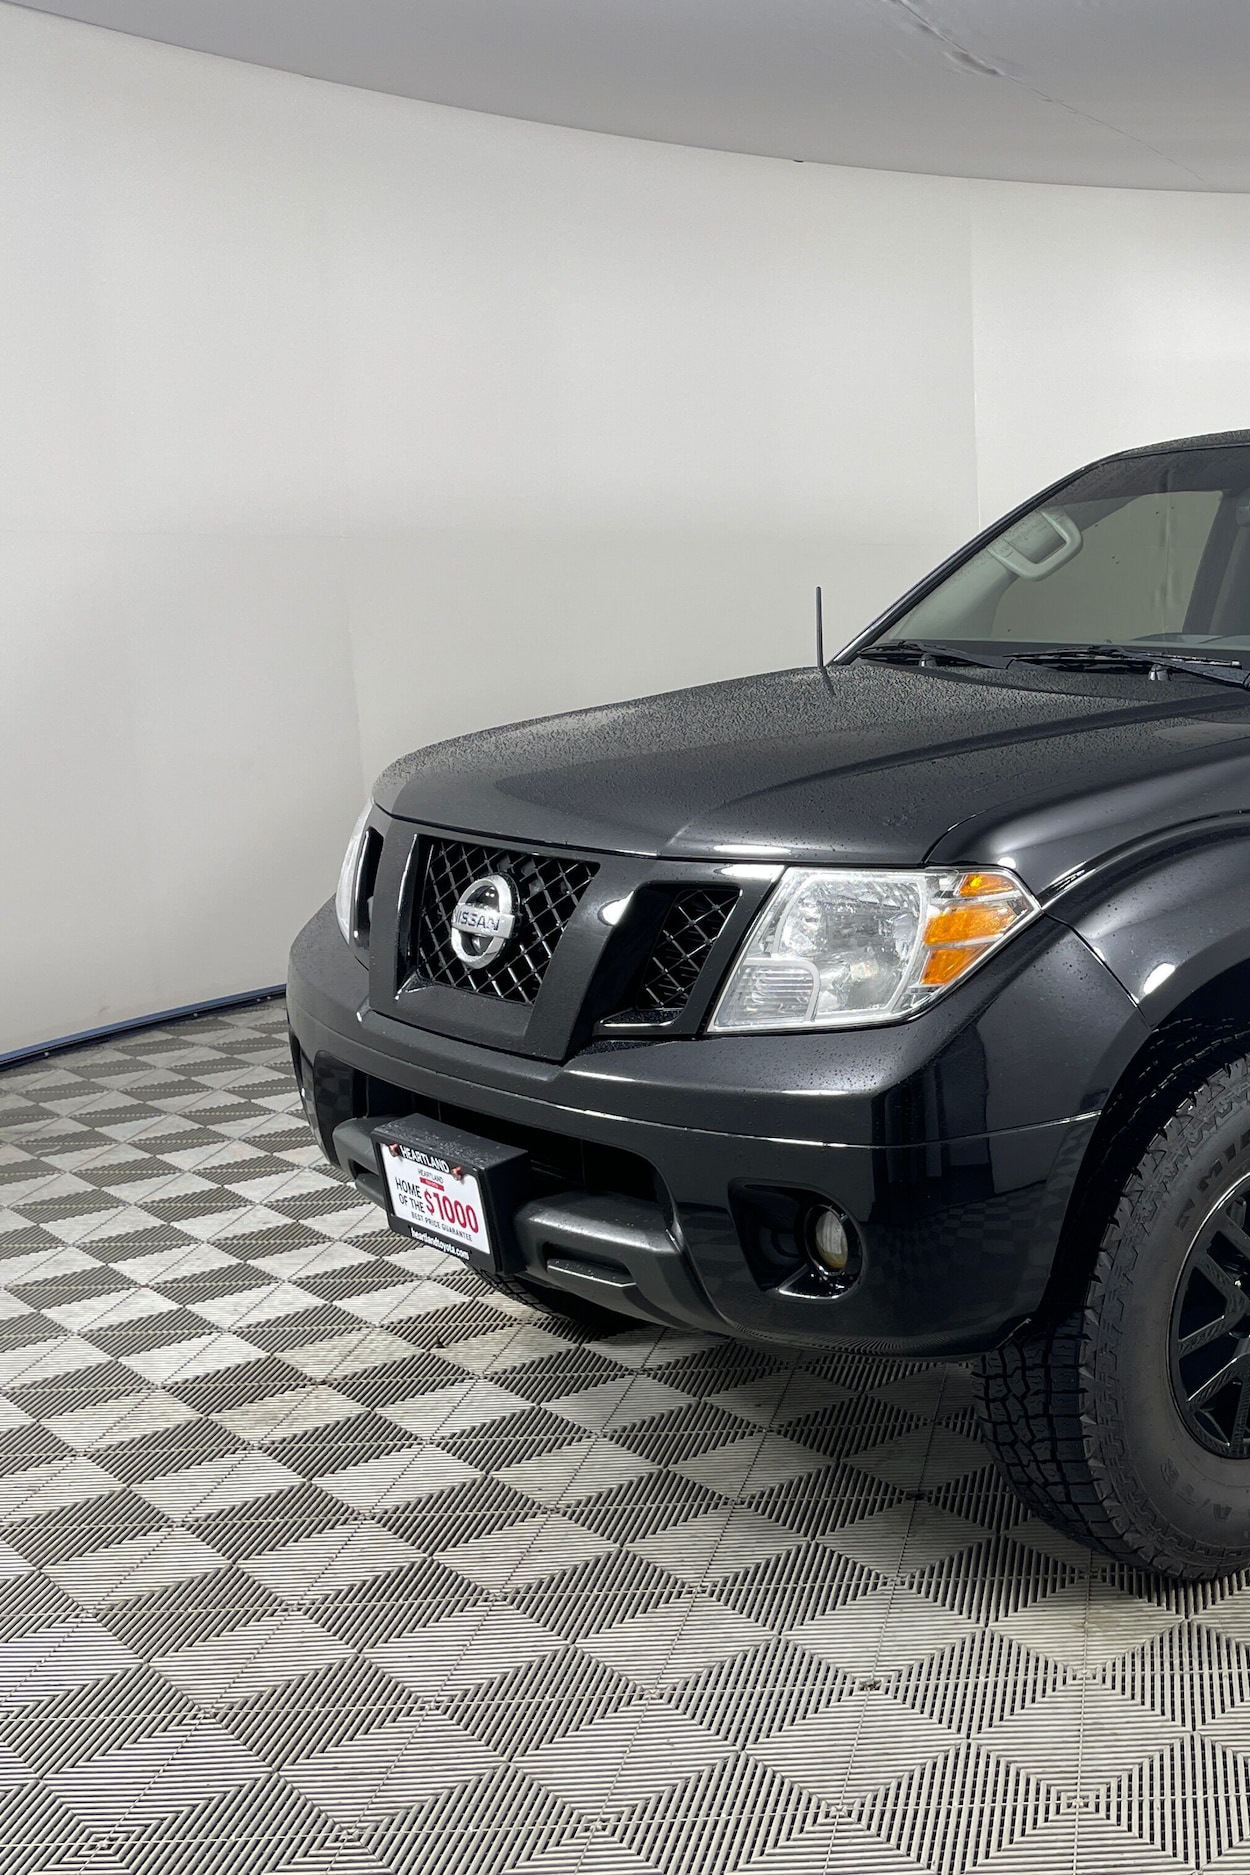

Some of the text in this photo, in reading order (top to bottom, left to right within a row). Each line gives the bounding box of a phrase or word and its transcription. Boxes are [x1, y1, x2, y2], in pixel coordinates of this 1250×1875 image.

[453, 908, 500, 932] NISSAN
[399, 1145, 450, 1174] HEARTLAND
[395, 1177, 423, 1199] HOME
[417, 1168, 444, 1185] HEARTLAND
[399, 1193, 426, 1213] OF THE
[423, 1188, 479, 1234] $1000
[411, 1211, 473, 1243] BEST PRICE GUARANTEE
